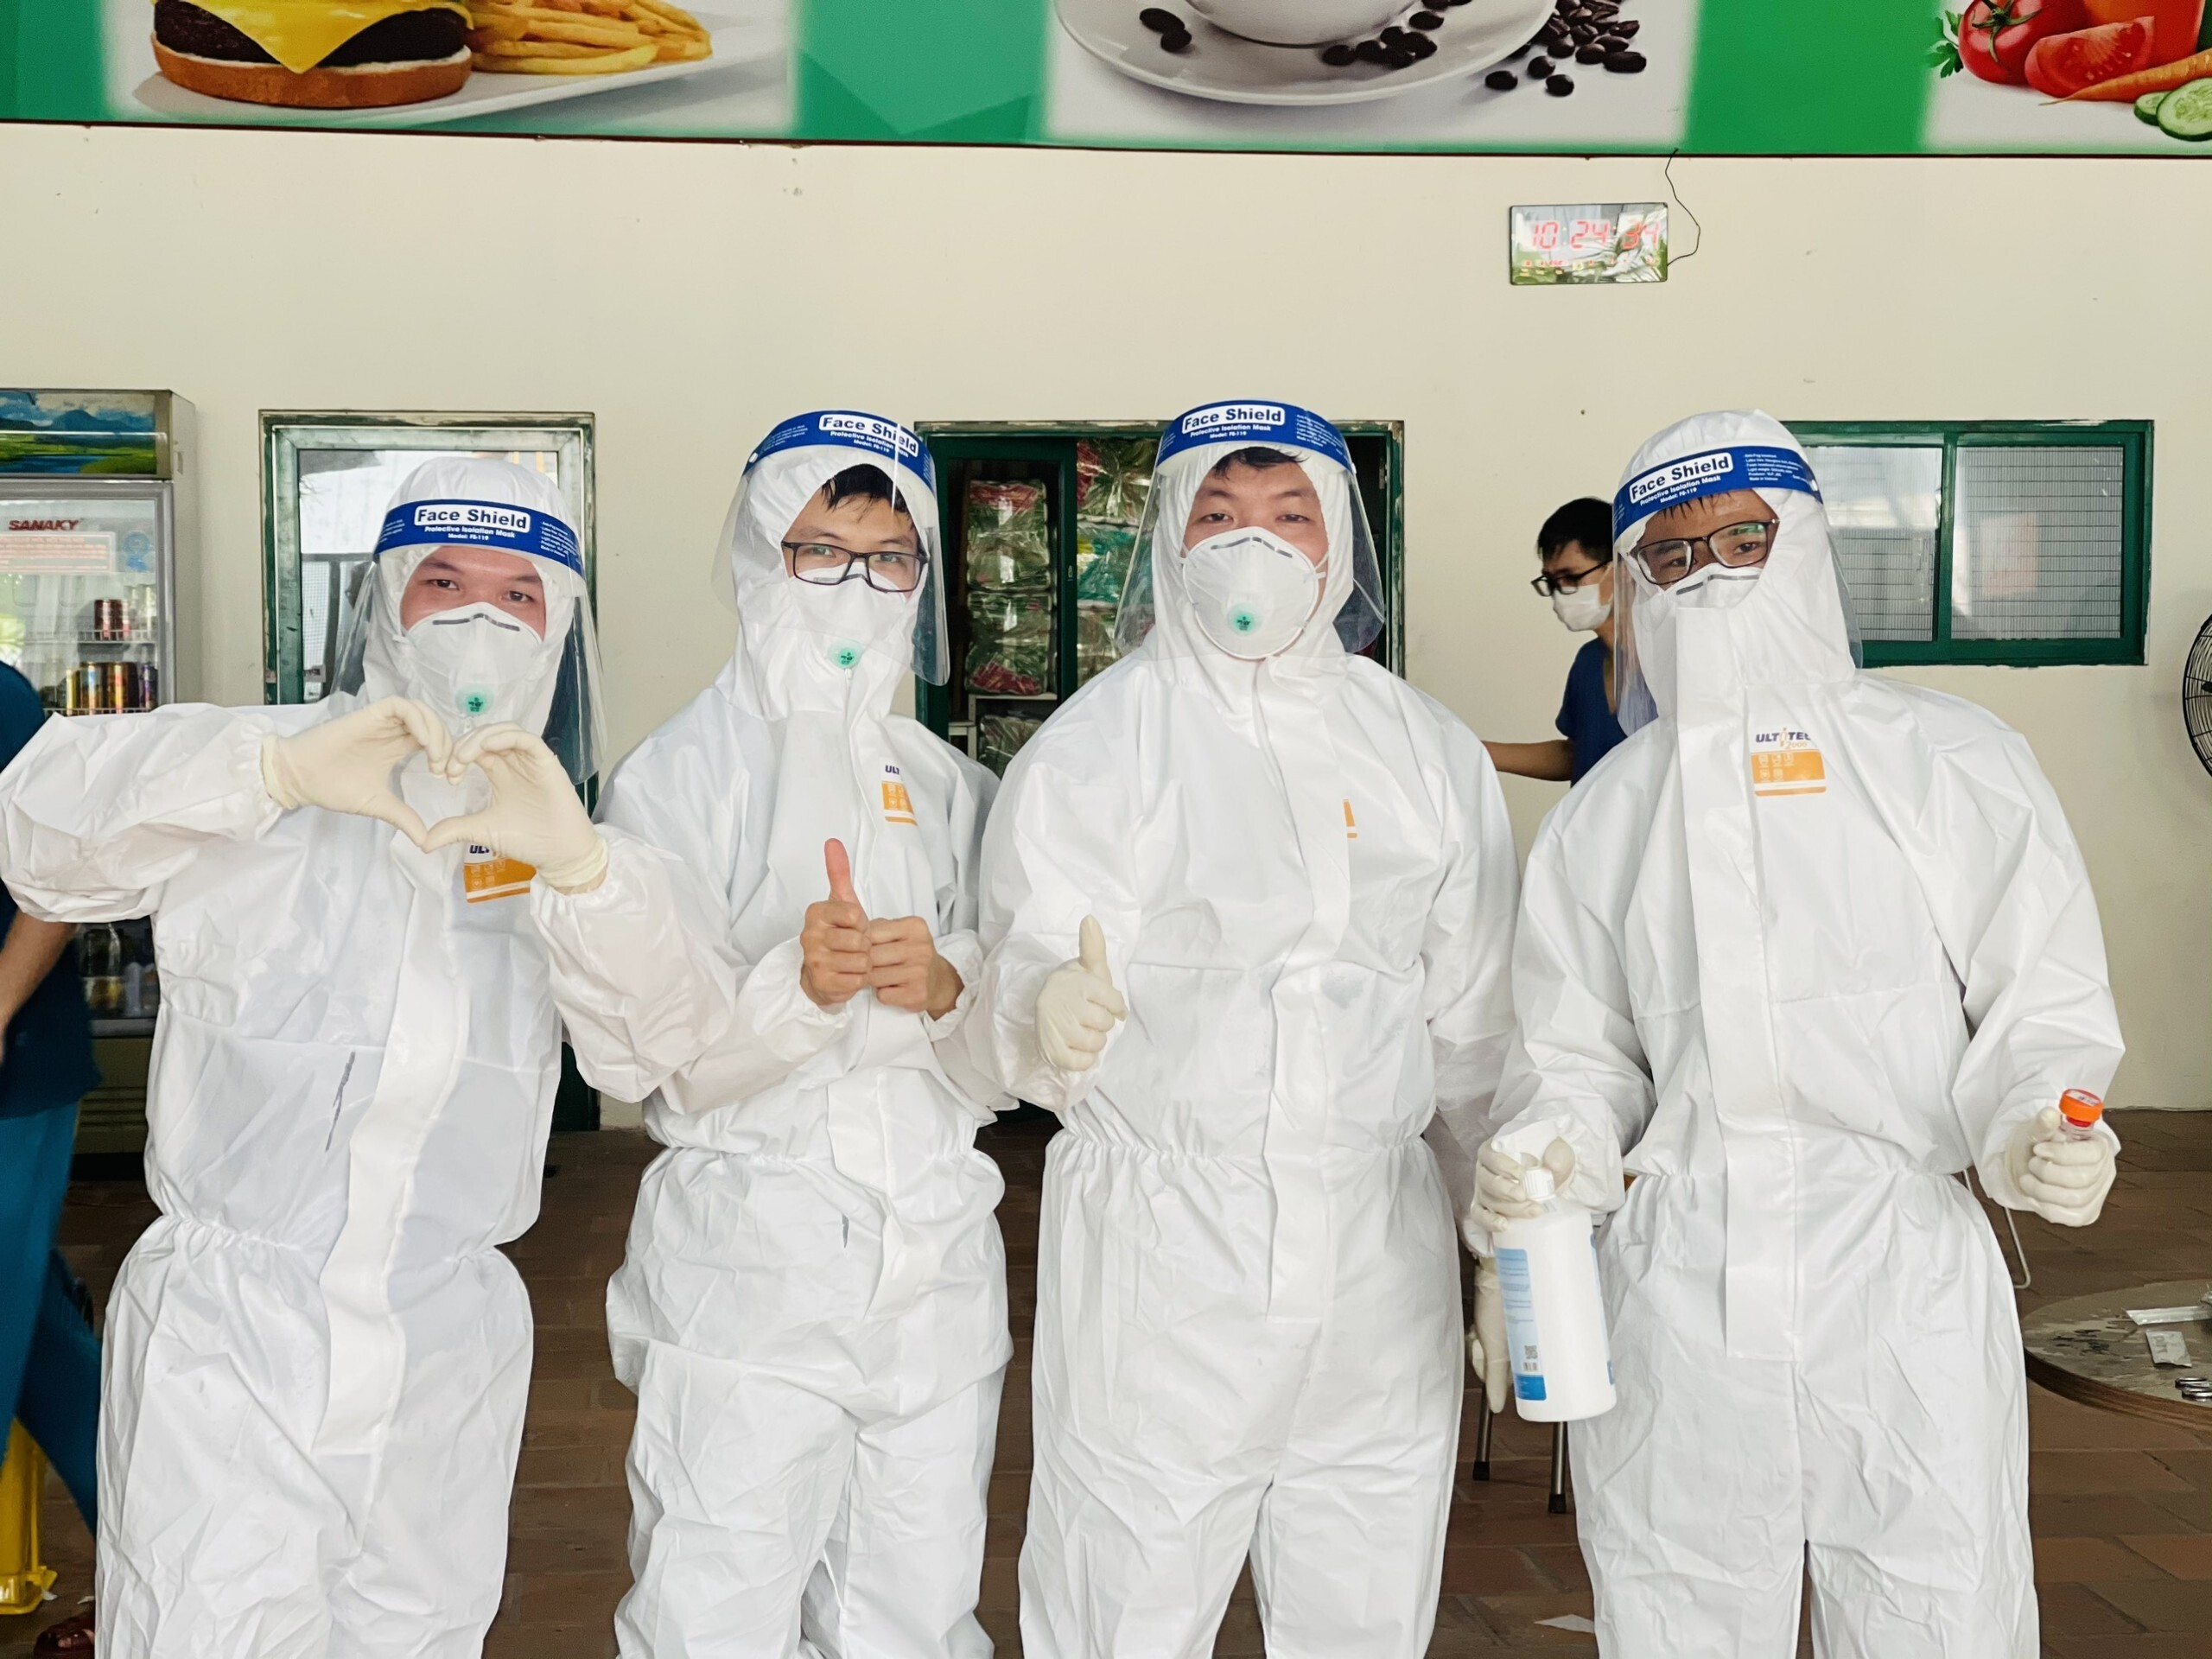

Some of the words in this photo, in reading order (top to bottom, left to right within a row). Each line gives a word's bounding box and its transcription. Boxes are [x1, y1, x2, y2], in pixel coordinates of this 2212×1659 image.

[1184, 412, 1220, 430] Face
[1225, 408, 1281, 423] Shield
[822, 416, 865, 430] Face
[871, 423, 917, 454] Shield
[866, 435, 894, 449] Isolation
[1630, 475, 1666, 499] Face
[1671, 456, 1729, 480] Shield
[1669, 480, 1700, 493] Isolation
[1701, 474, 1721, 484] Mask
[8, 519, 79, 531] SANAKY
[416, 509, 461, 523] Face
[467, 509, 527, 529] Shield
[461, 526, 494, 535] Isolation
[495, 530, 516, 538] Mask
